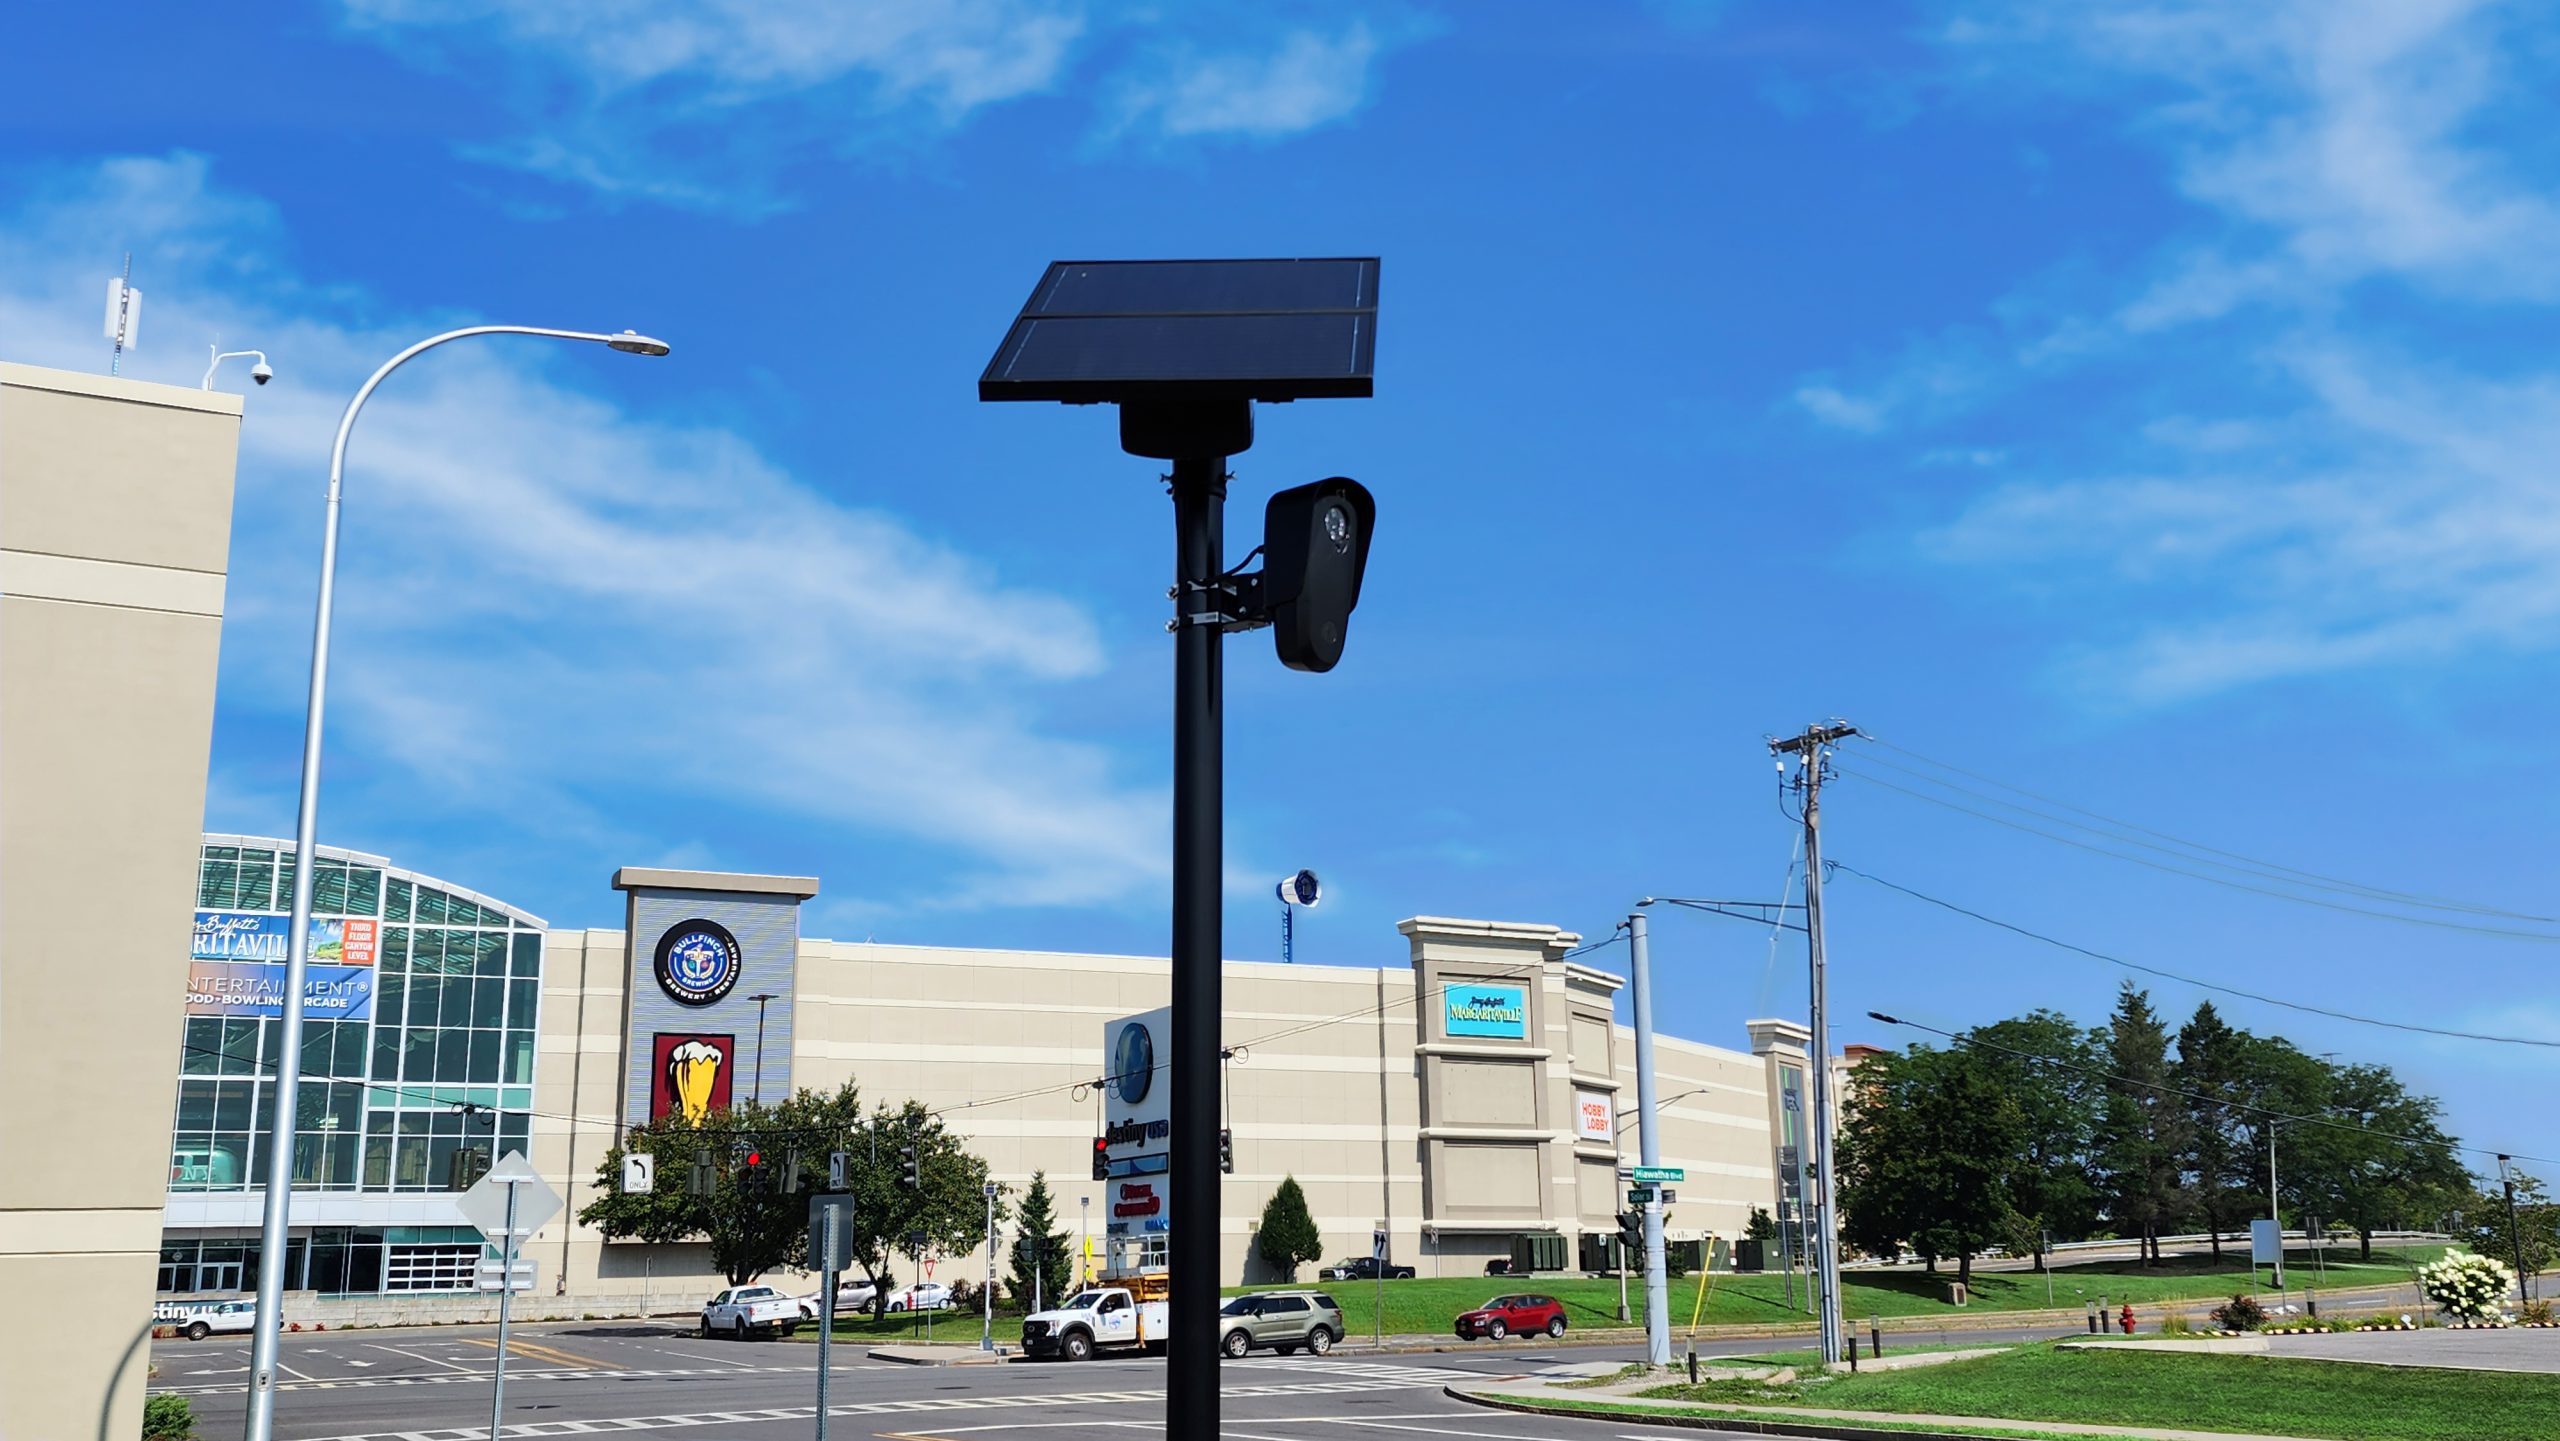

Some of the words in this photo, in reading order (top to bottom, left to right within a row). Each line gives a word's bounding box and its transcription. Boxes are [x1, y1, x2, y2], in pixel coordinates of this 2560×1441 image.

[350, 922, 372, 931] THIRD
[348, 932, 372, 941] FLOOR
[344, 941, 374, 951] CANYON
[673, 934, 725, 957] BULLFINCH
[347, 951, 369, 960] LEVEL
[665, 978, 706, 1000] BREWERY
[714, 942, 739, 995] RESTAURANT
[682, 978, 714, 987] BREWING
[1582, 1103, 1607, 1117] HOBBY
[1587, 1118, 1609, 1131] LOBBY
[1106, 1117, 1147, 1147] destiny
[1635, 1168, 1670, 1180] Hiawatha
[1670, 1172, 1683, 1180] Blvd
[629, 1180, 648, 1189] ONLY
